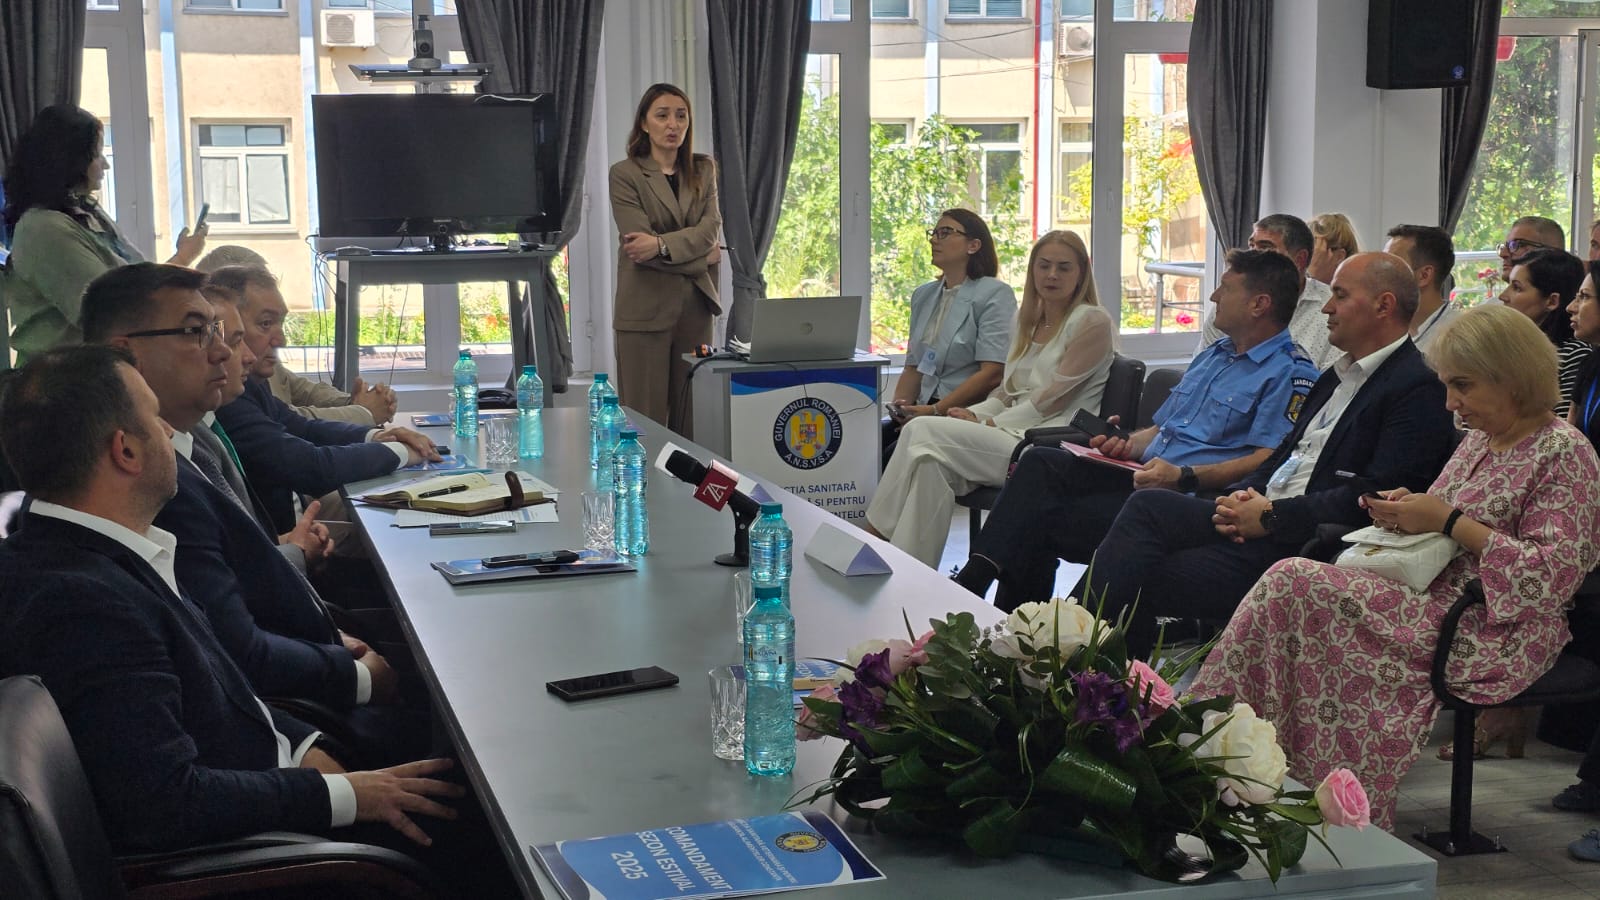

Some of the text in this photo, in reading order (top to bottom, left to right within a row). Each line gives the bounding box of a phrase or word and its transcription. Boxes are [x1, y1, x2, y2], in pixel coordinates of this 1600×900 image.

[774, 399, 810, 442] GUVERNUL
[808, 481, 857, 494] SANITARĂ
[826, 496, 866, 507] PENTRU
[610, 850, 649, 880] 2025
[635, 830, 697, 892] SEZON ESTIVAL
[664, 826, 733, 890] COMANDAMENT
